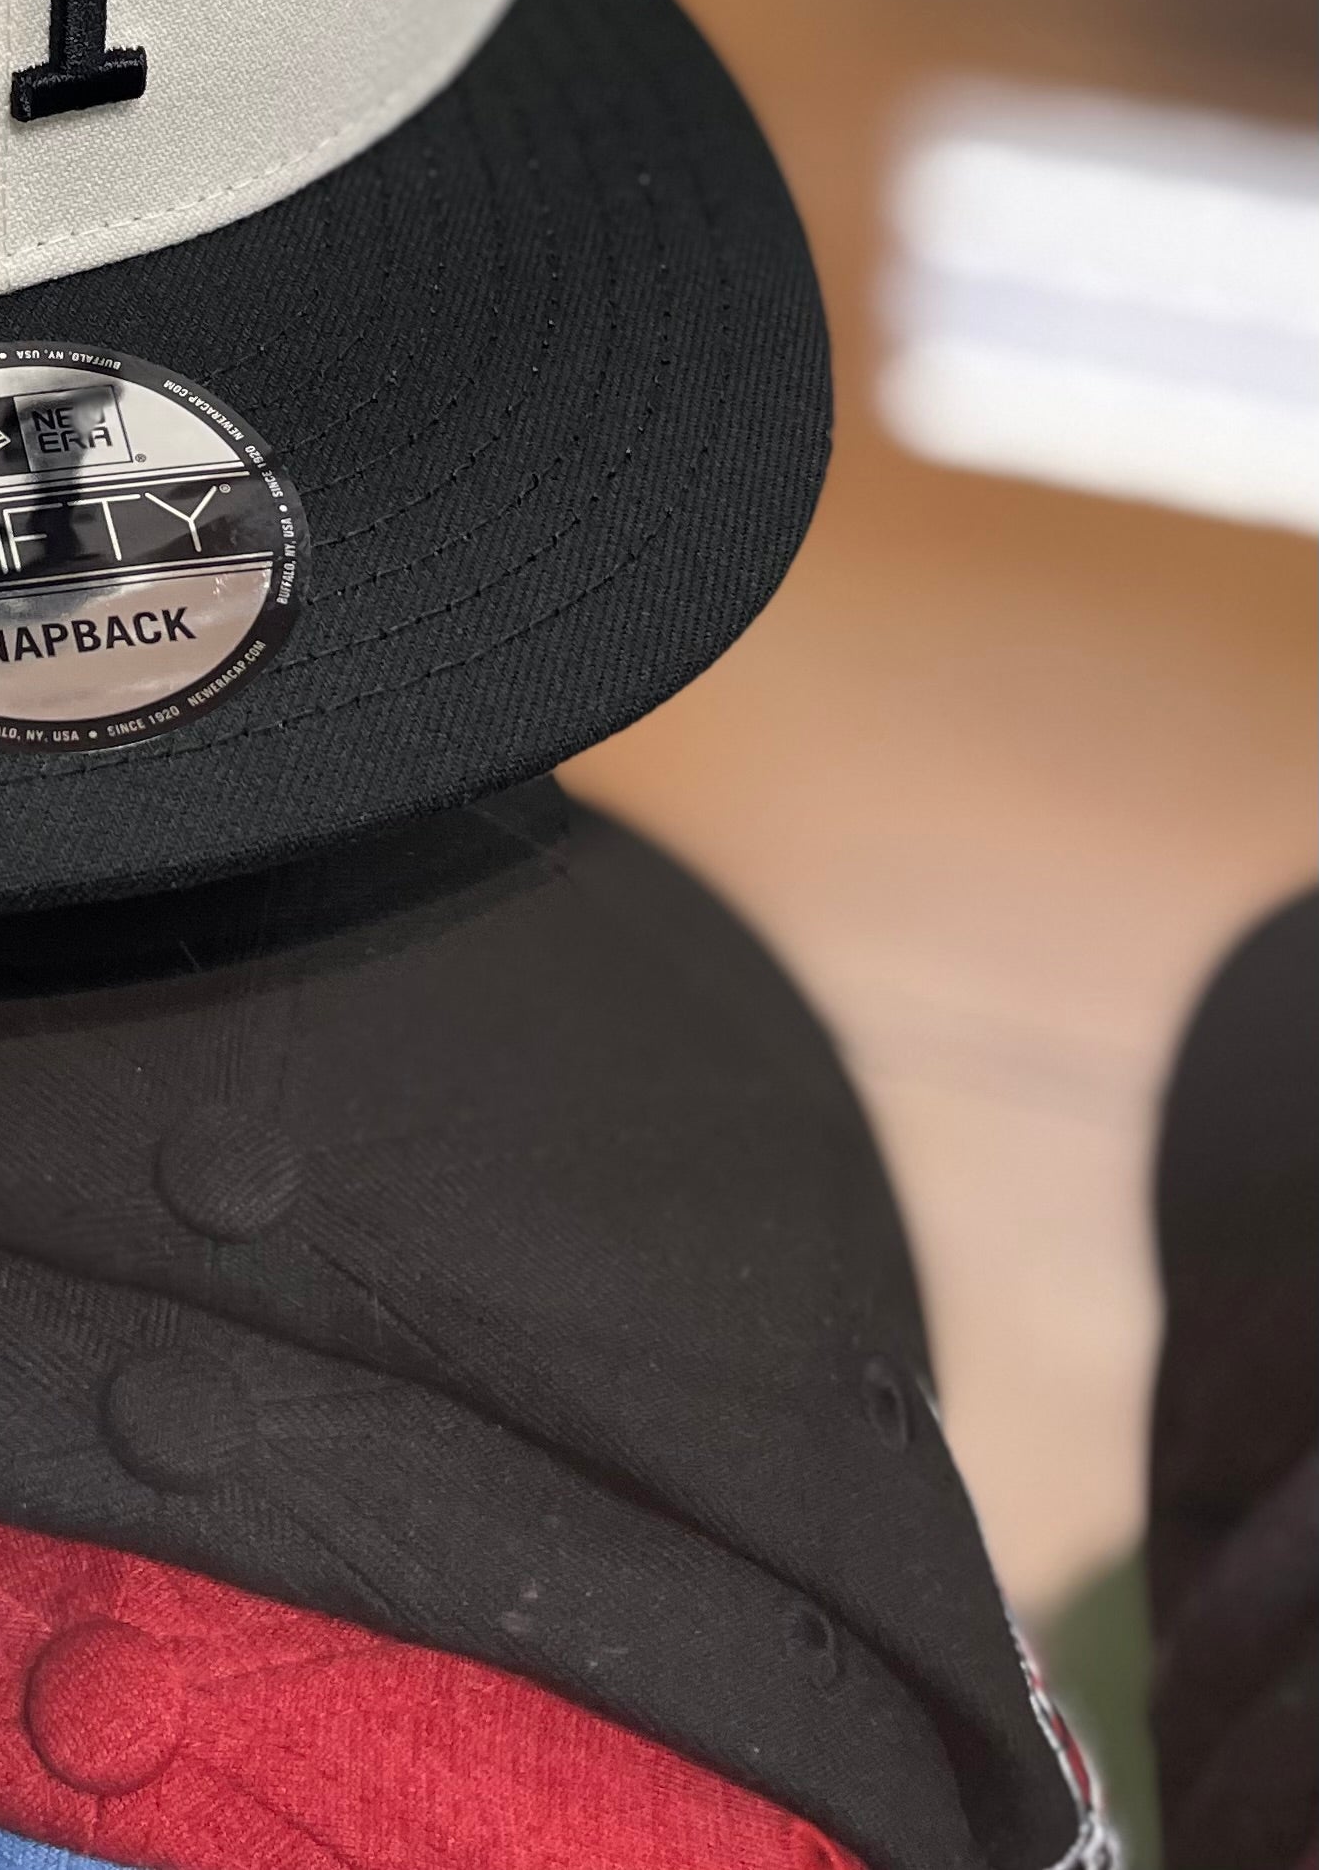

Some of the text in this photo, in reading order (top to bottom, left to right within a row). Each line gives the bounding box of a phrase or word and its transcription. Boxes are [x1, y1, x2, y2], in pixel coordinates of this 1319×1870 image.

[16, 350, 40, 359] USA
[32, 406, 106, 432] NE
[163, 379, 245, 441] NEWERACAP.COM
[244, 445, 266, 468] 1920
[261, 471, 284, 498] SINCE
[280, 518, 294, 538] USA
[53, 731, 79, 741] USA
[107, 718, 146, 737] SINCE
[148, 705, 180, 725] 1920
[187, 639, 267, 707] NEWERACAP.COM
